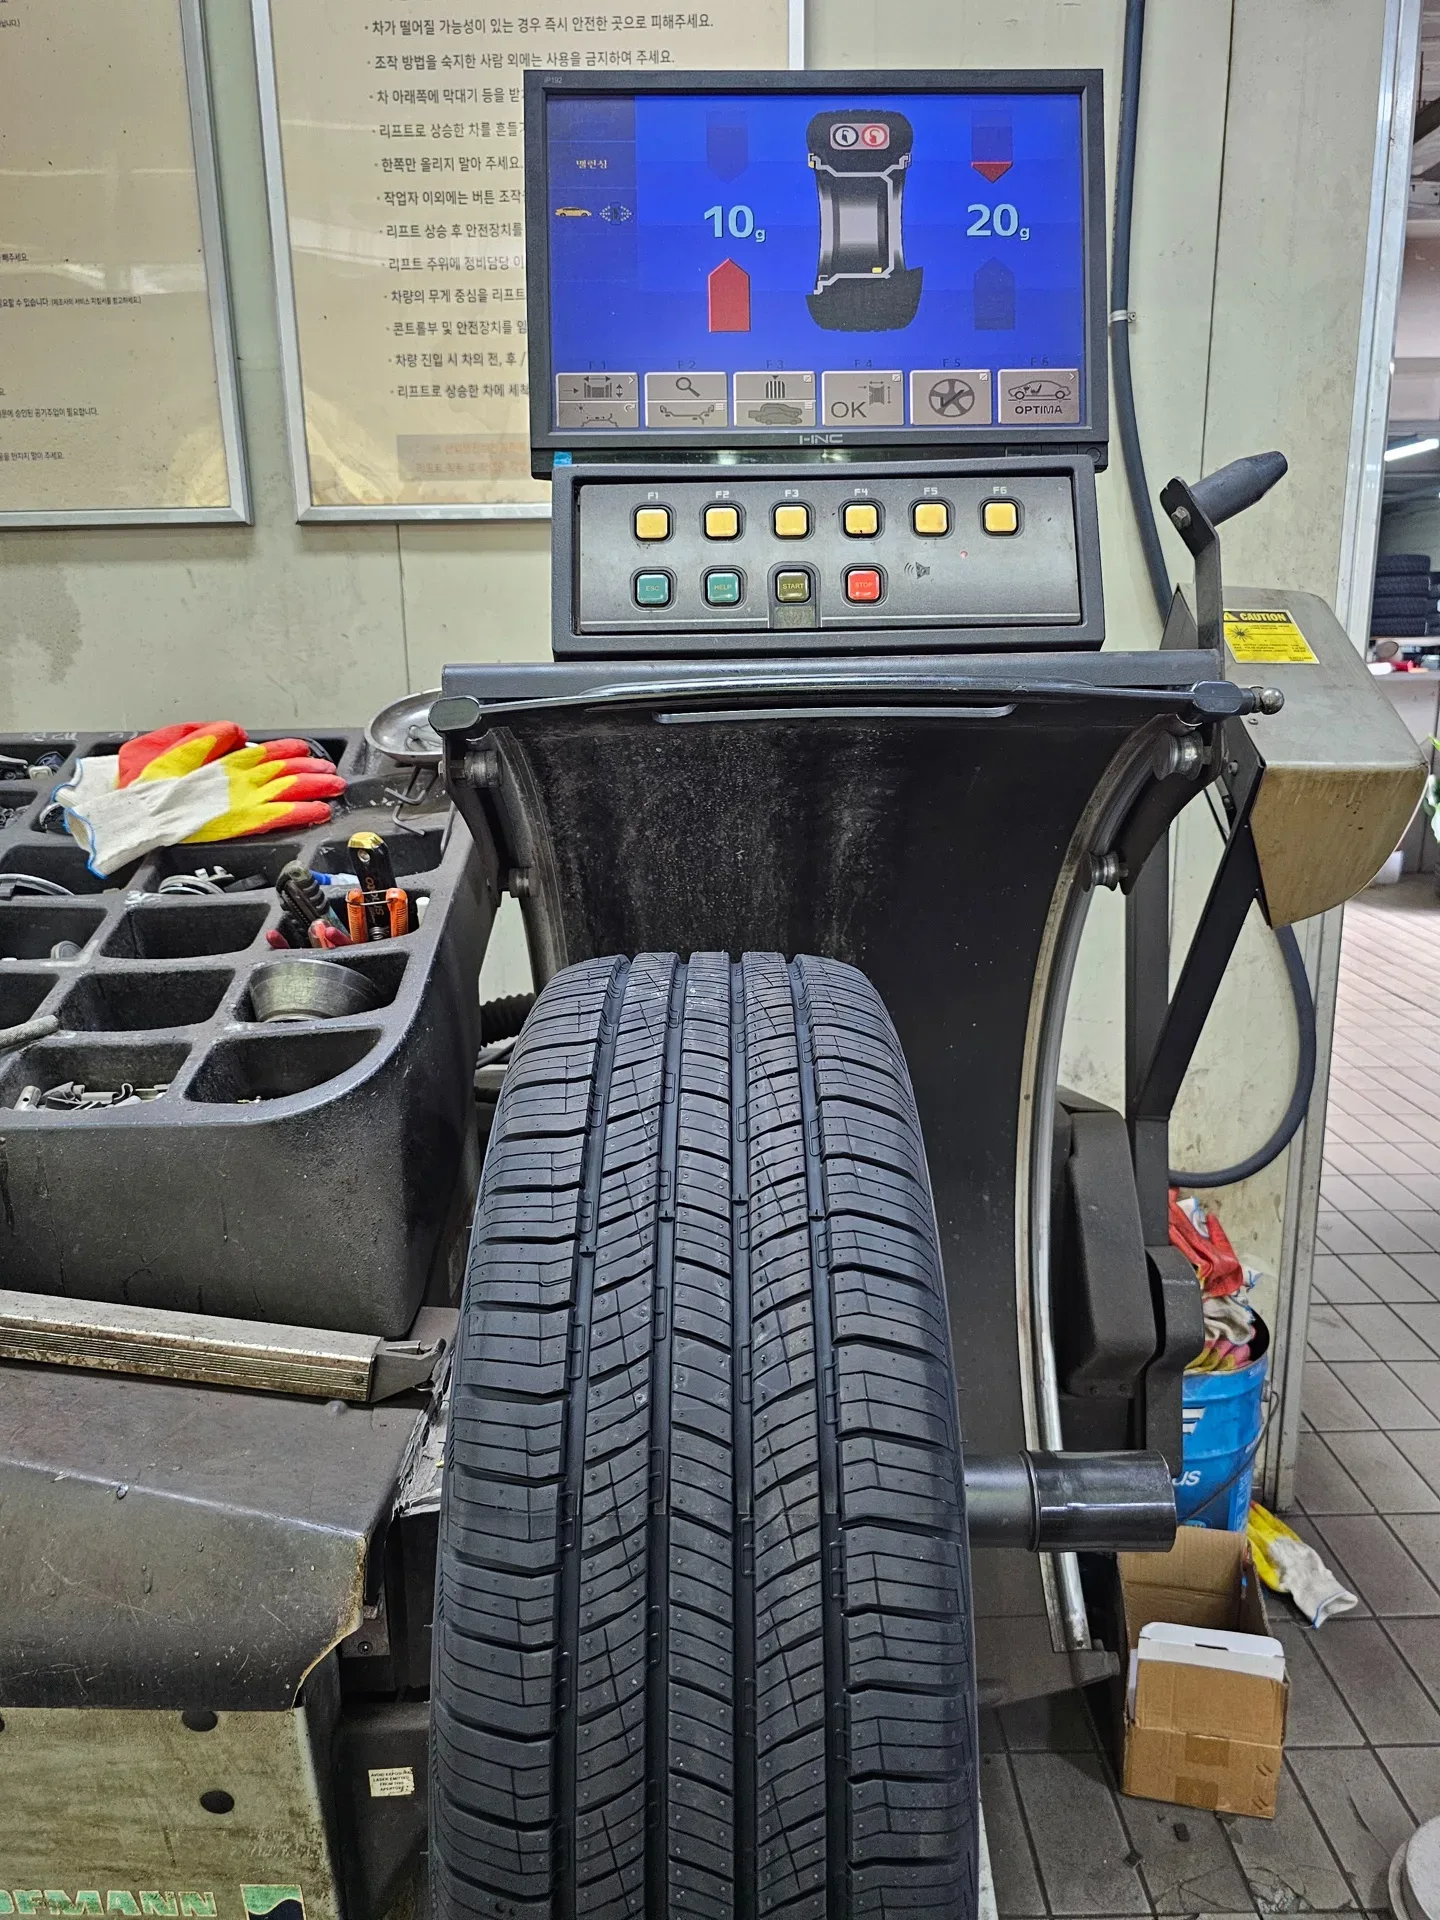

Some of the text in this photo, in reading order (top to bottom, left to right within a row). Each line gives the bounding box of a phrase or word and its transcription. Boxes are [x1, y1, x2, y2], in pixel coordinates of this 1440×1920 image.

[372, 14, 713, 36] 차가 떨어질 가능성이 있는 경우 즉시 안전한 곳으로 피해주세요.
[375, 50, 674, 70] 조작 방법을 숙지한 사람 외에는 사용을 금지하여 주세요.
[377, 87, 524, 104] 차 아래쪽에 막대기 등을 받
[380, 124, 426, 139] 리프트로
[430, 123, 464, 138] 상승한
[468, 122, 491, 137] 차를
[381, 158, 416, 172] 한쪽만
[420, 157, 454, 172] 올리지
[459, 157, 481, 172] 말아
[384, 189, 524, 206] 작업자 이외에는 버튼 조작
[386, 222, 522, 239] 리프트 상승 후 안전장치를
[389, 258, 424, 272] 리프트
[427, 257, 460, 272] 주위에
[464, 257, 509, 272] 정비담당
[391, 290, 424, 304] 차량의
[428, 289, 450, 303] 무게
[455, 288, 488, 303] 중심을
[393, 322, 438, 336] 콘트롤부
[442, 321, 452, 335] 및
[457, 320, 512, 335] 안전장치를
[396, 354, 417, 368] 차량
[422, 353, 443, 367] 진입
[448, 353, 457, 366] 시
[462, 353, 483, 366] 차의
[488, 352, 502, 366] 전,
[506, 352, 516, 366] 후
[398, 385, 442, 399] 리프트로
[445, 384, 479, 398] 상승한
[483, 384, 504, 397] 차에
[830, 401, 867, 419] OK
[1014, 405, 1063, 415] OPTIMA
[647, 491, 659, 500] F1
[715, 490, 730, 499] F2
[784, 489, 799, 498] F3
[853, 488, 869, 497] F4
[923, 486, 939, 496] F5
[992, 485, 1007, 495] F6
[1239, 612, 1287, 622] CAUTION
